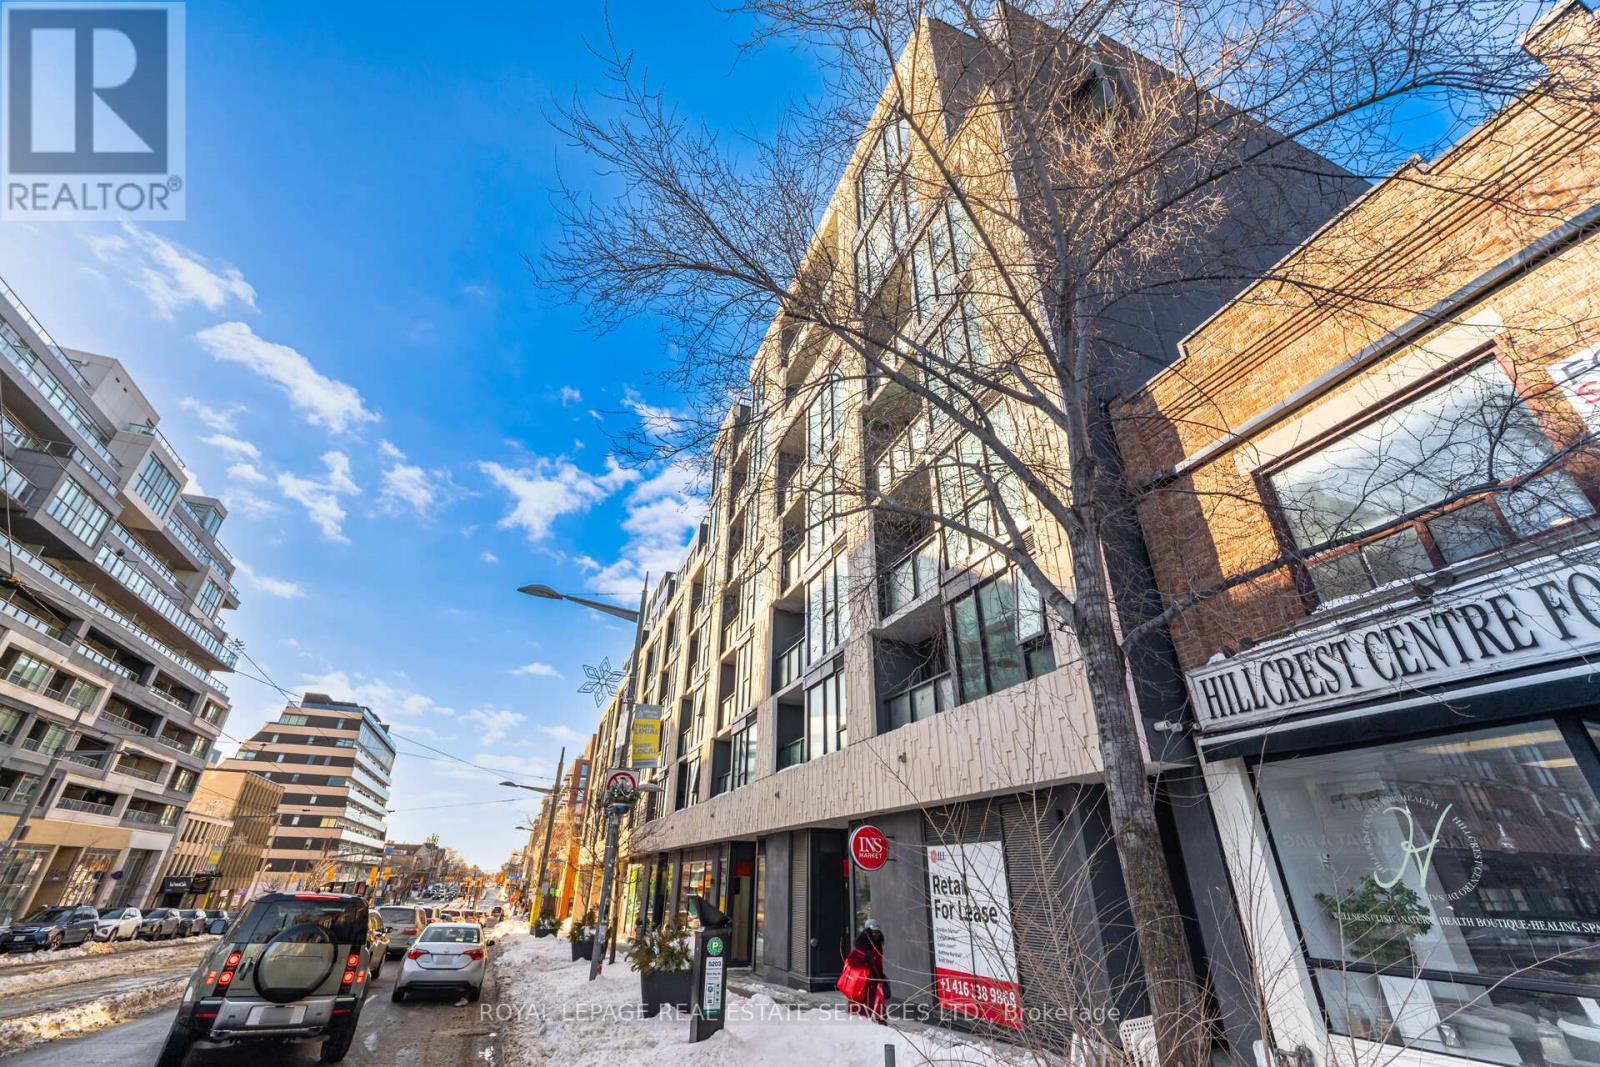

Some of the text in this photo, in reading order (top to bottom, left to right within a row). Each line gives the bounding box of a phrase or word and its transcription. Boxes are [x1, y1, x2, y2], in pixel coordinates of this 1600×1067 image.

[1200, 638, 1361, 719] HILLCREST
[1364, 594, 1540, 681] CENTRE
[858, 836, 883, 853] INS
[1459, 863, 1483, 896] CENTRO
[934, 899, 998, 925] For Lease
[1440, 916, 1474, 927] HEALTH
[952, 978, 970, 997] 416
